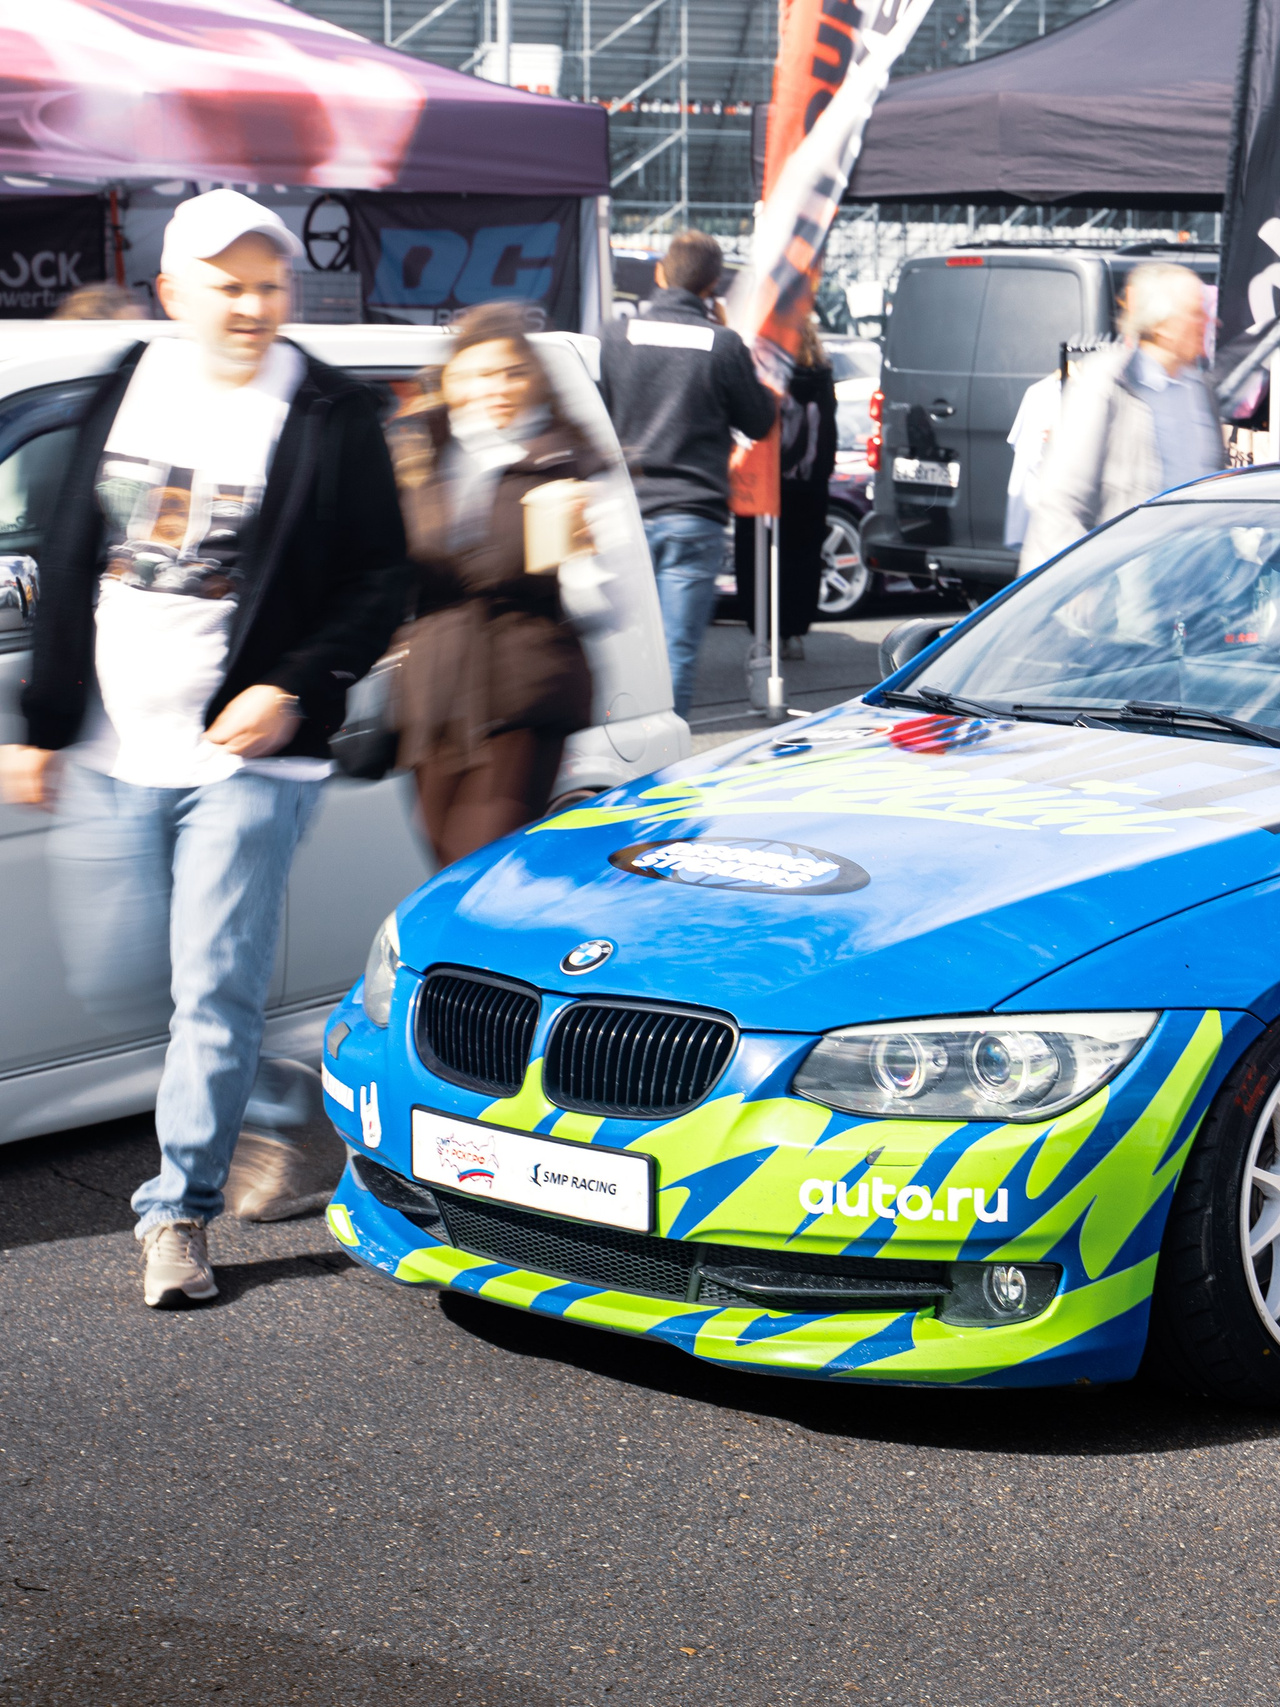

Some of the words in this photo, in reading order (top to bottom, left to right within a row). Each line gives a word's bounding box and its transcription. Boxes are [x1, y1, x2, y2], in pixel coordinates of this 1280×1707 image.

[543, 1170, 569, 1186] SMP
[571, 1176, 617, 1196] RACING
[798, 1176, 1009, 1223] auto.ru
